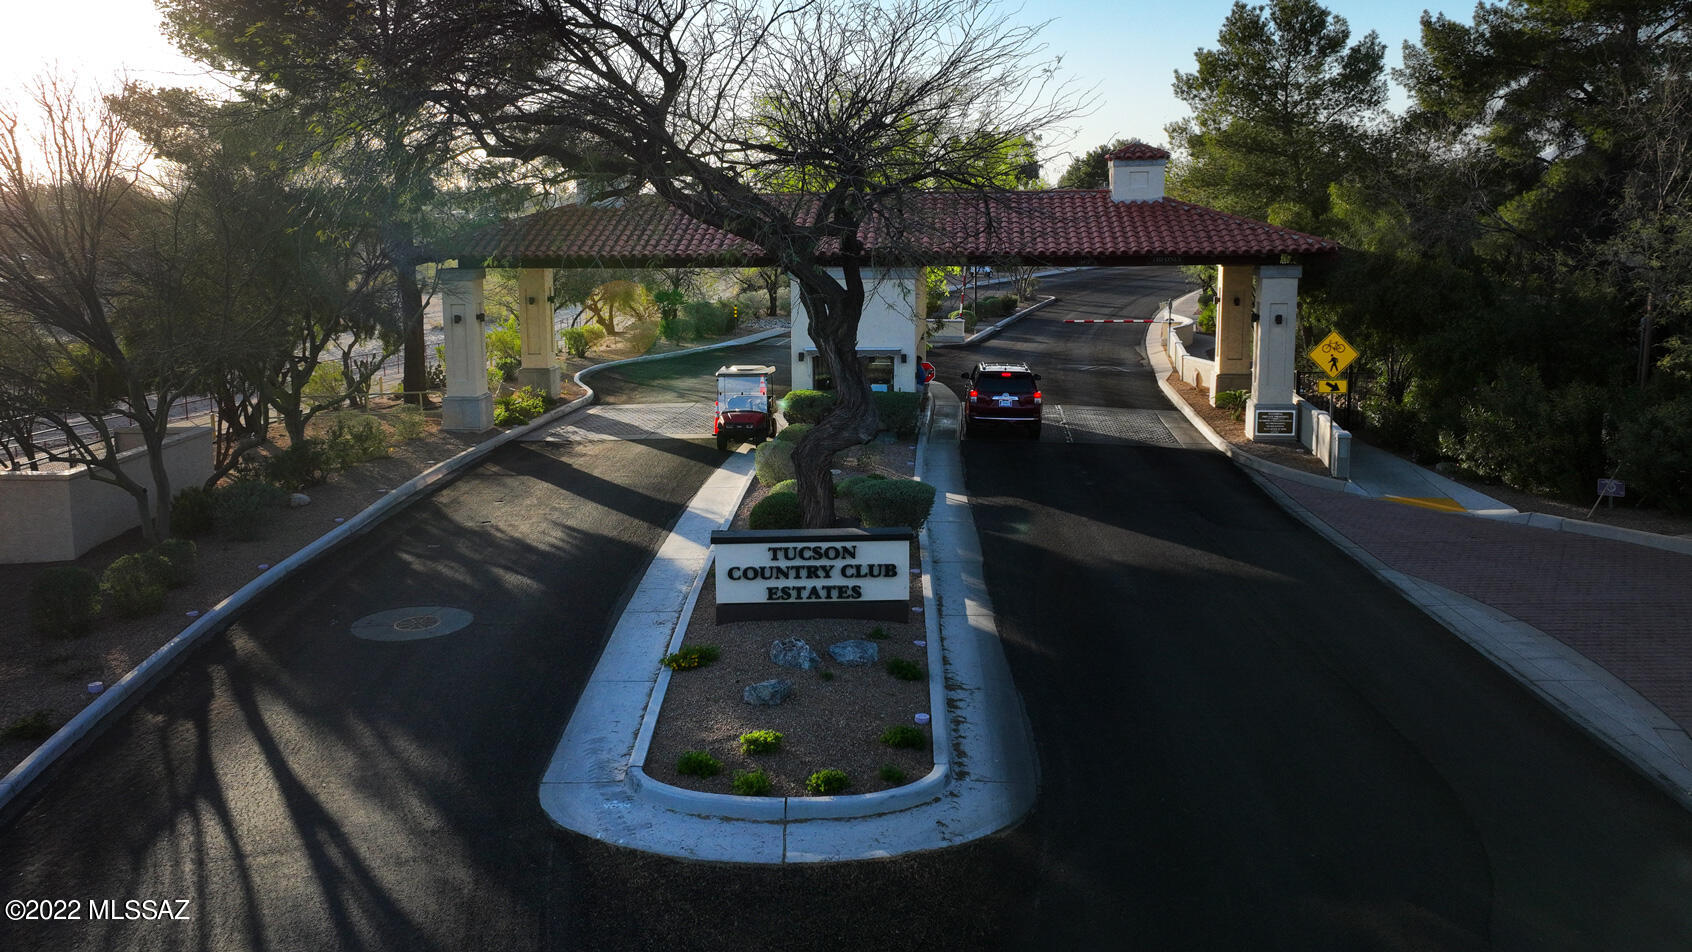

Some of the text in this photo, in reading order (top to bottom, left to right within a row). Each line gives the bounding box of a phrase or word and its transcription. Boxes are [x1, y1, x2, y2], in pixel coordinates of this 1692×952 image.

[768, 545, 857, 561] TUCSON
[727, 563, 898, 581] COUNTRY CLUB
[766, 585, 862, 600] ESTATES
